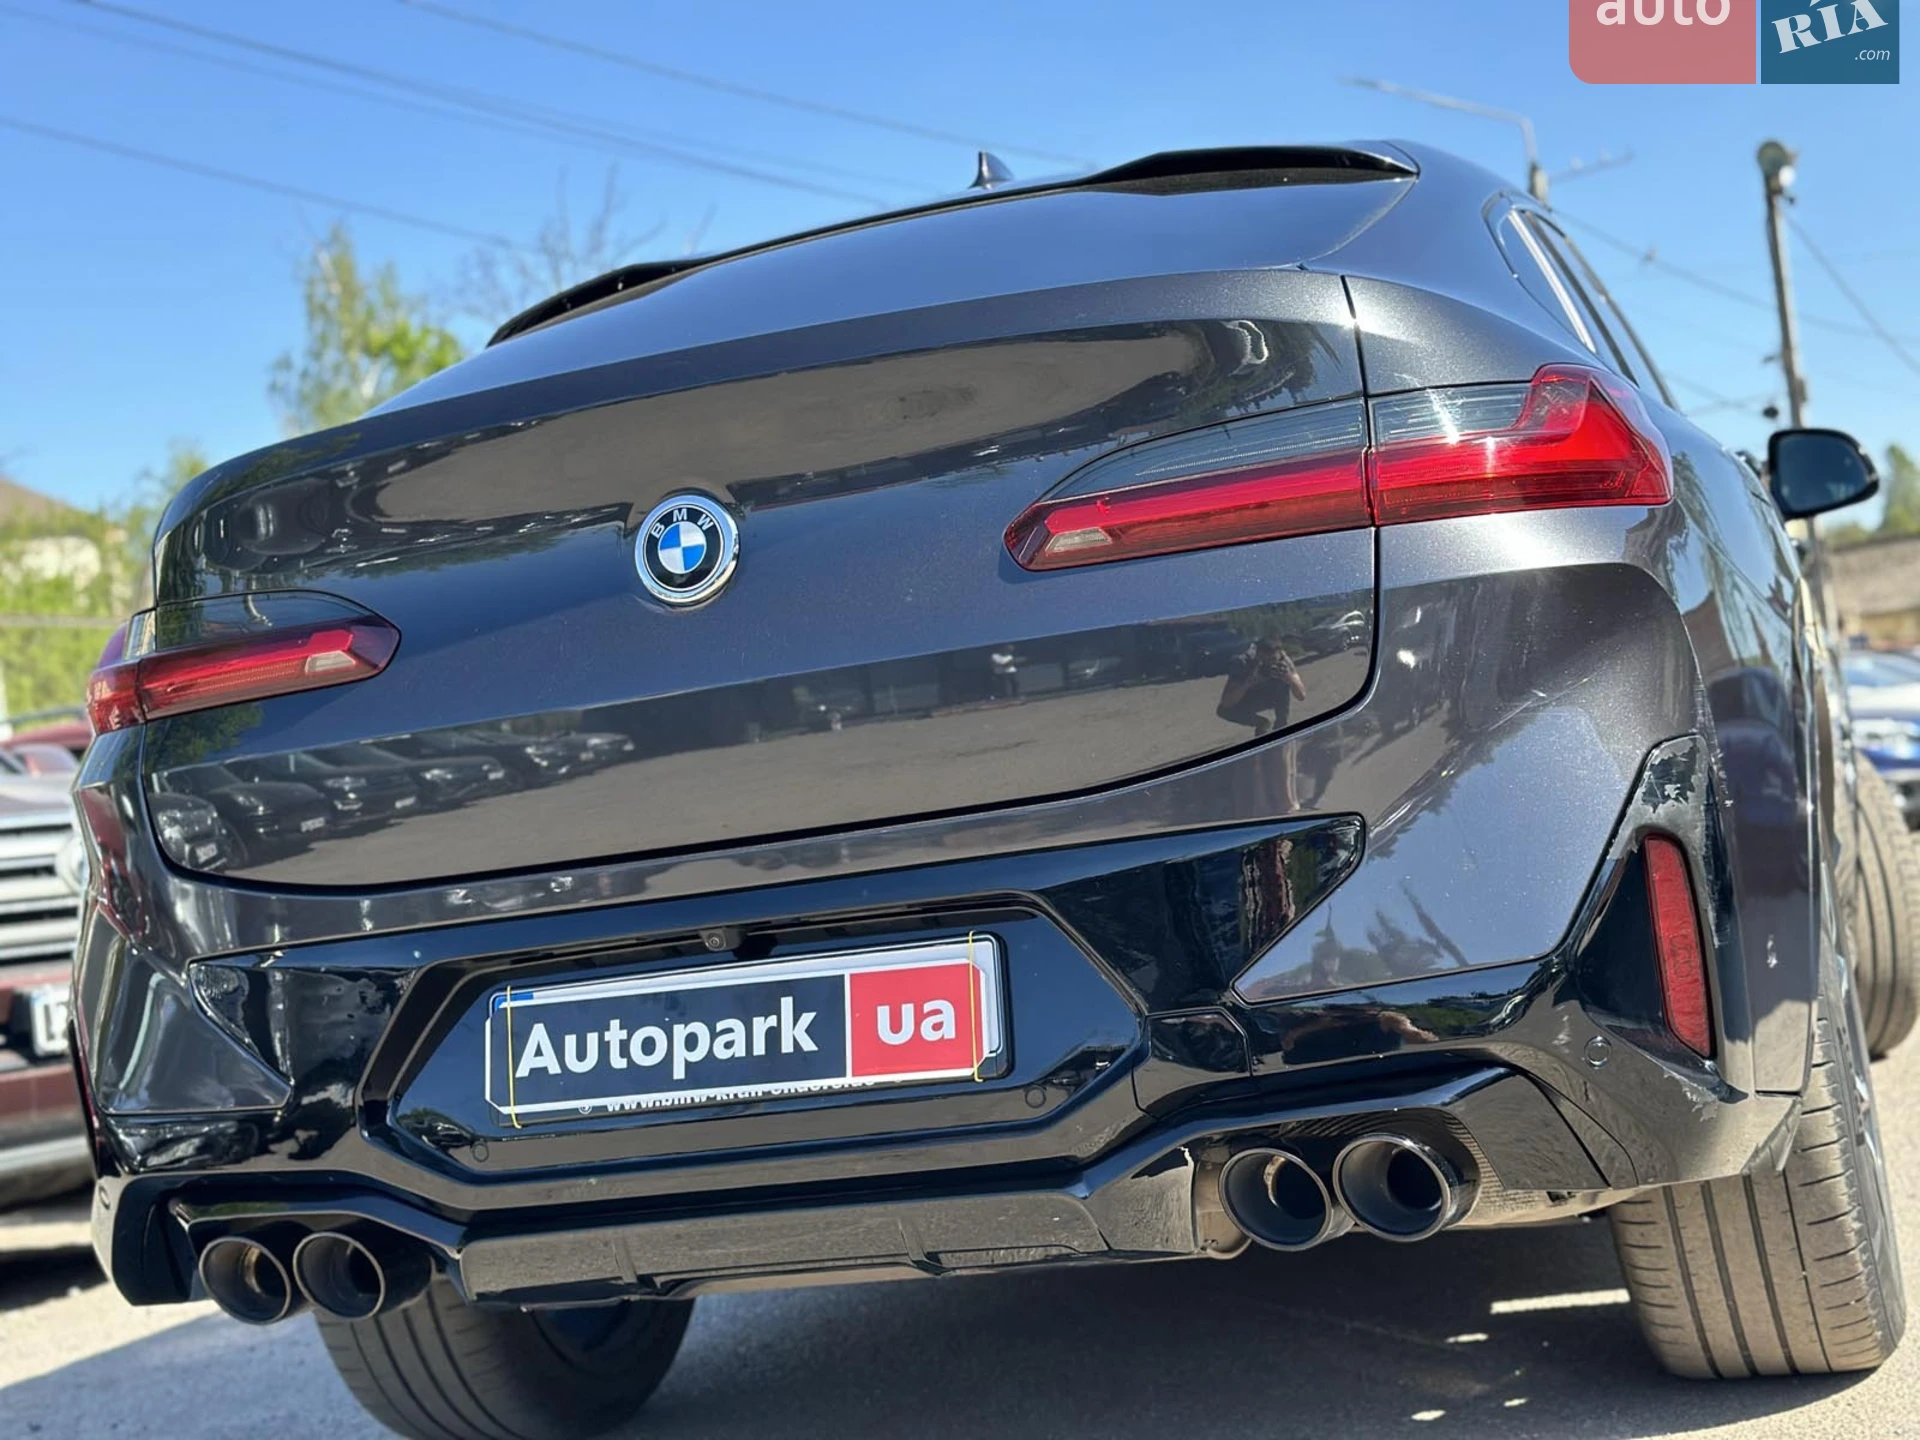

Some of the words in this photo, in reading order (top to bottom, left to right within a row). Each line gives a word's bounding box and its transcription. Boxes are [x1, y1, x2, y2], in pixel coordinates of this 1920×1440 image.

[651, 508, 714, 539] BMW
[516, 997, 818, 1079] Autopark
[876, 999, 956, 1046] ua
